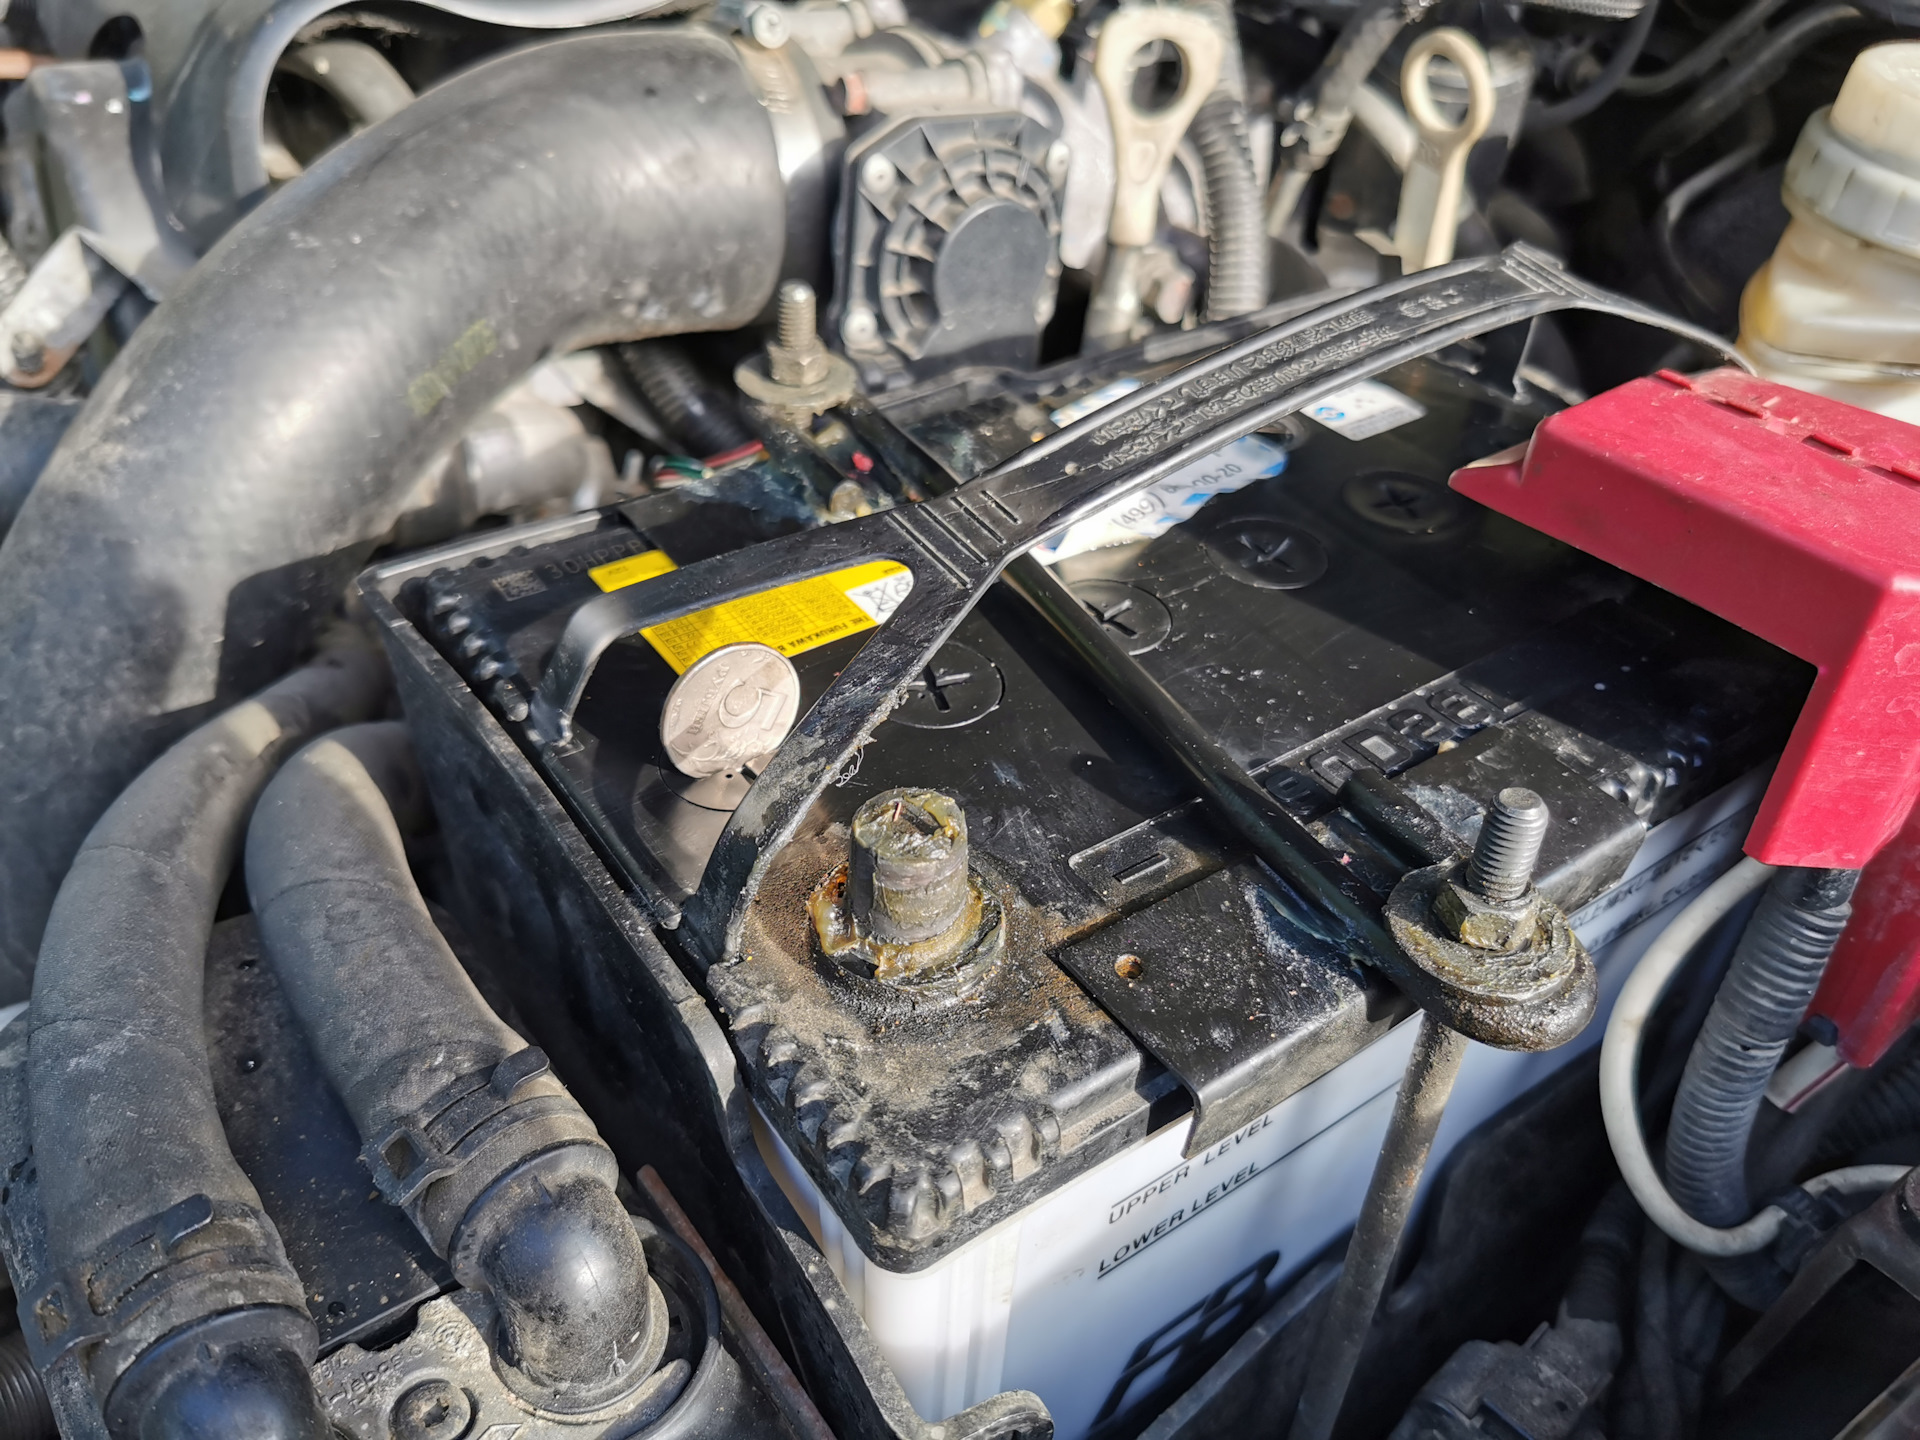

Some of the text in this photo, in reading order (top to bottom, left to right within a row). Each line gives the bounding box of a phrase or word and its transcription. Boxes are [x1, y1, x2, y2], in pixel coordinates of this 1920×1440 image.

[788, 623, 848, 648] FURUKAWA
[687, 663, 730, 736] РУБЛЕЙ
[718, 678, 788, 731] 5
[1107, 1113, 1273, 1225] UPPER LEVEL
[1098, 1161, 1261, 1274] LOWER LEVEL
